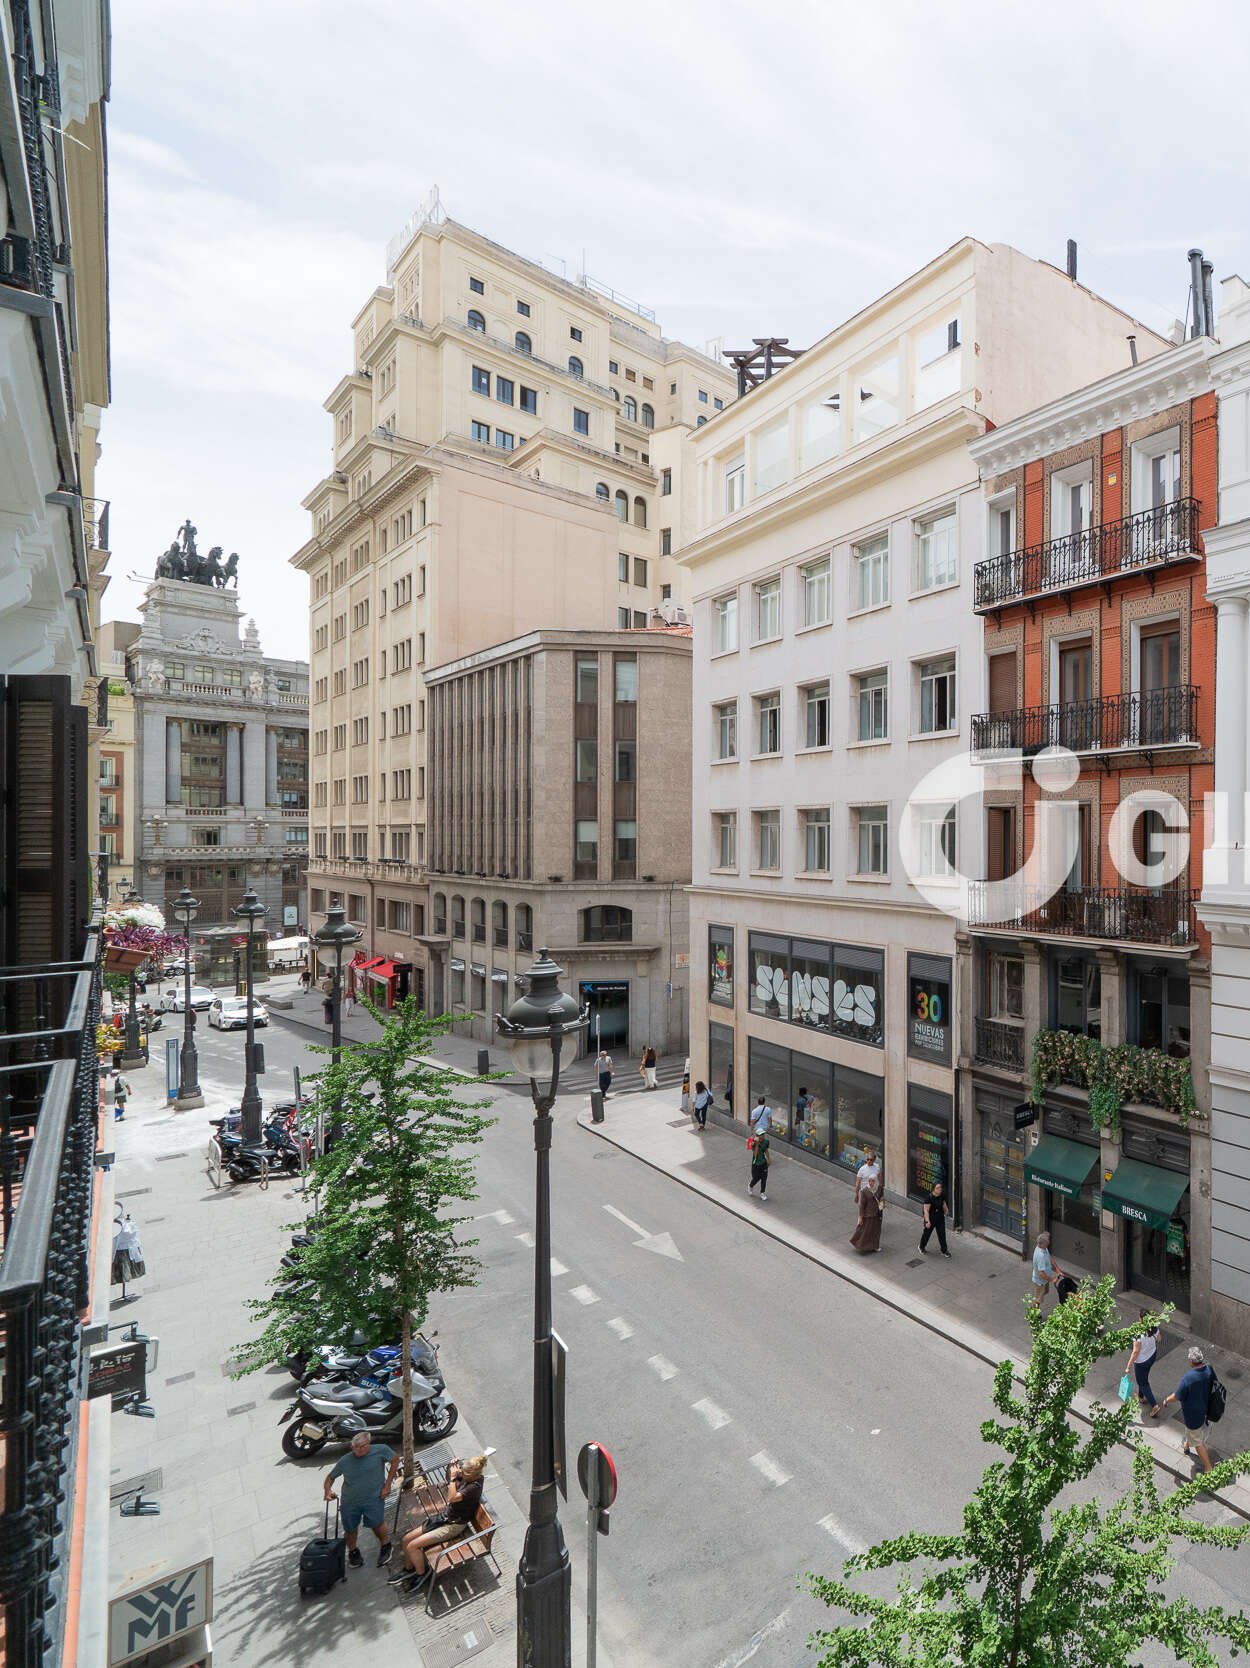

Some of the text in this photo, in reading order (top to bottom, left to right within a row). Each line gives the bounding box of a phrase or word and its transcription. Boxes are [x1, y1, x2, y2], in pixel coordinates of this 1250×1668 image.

[917, 991, 942, 1023] 30
[914, 1023, 945, 1040] NUEVAS
[1121, 1205, 1147, 1222] BRESCA
